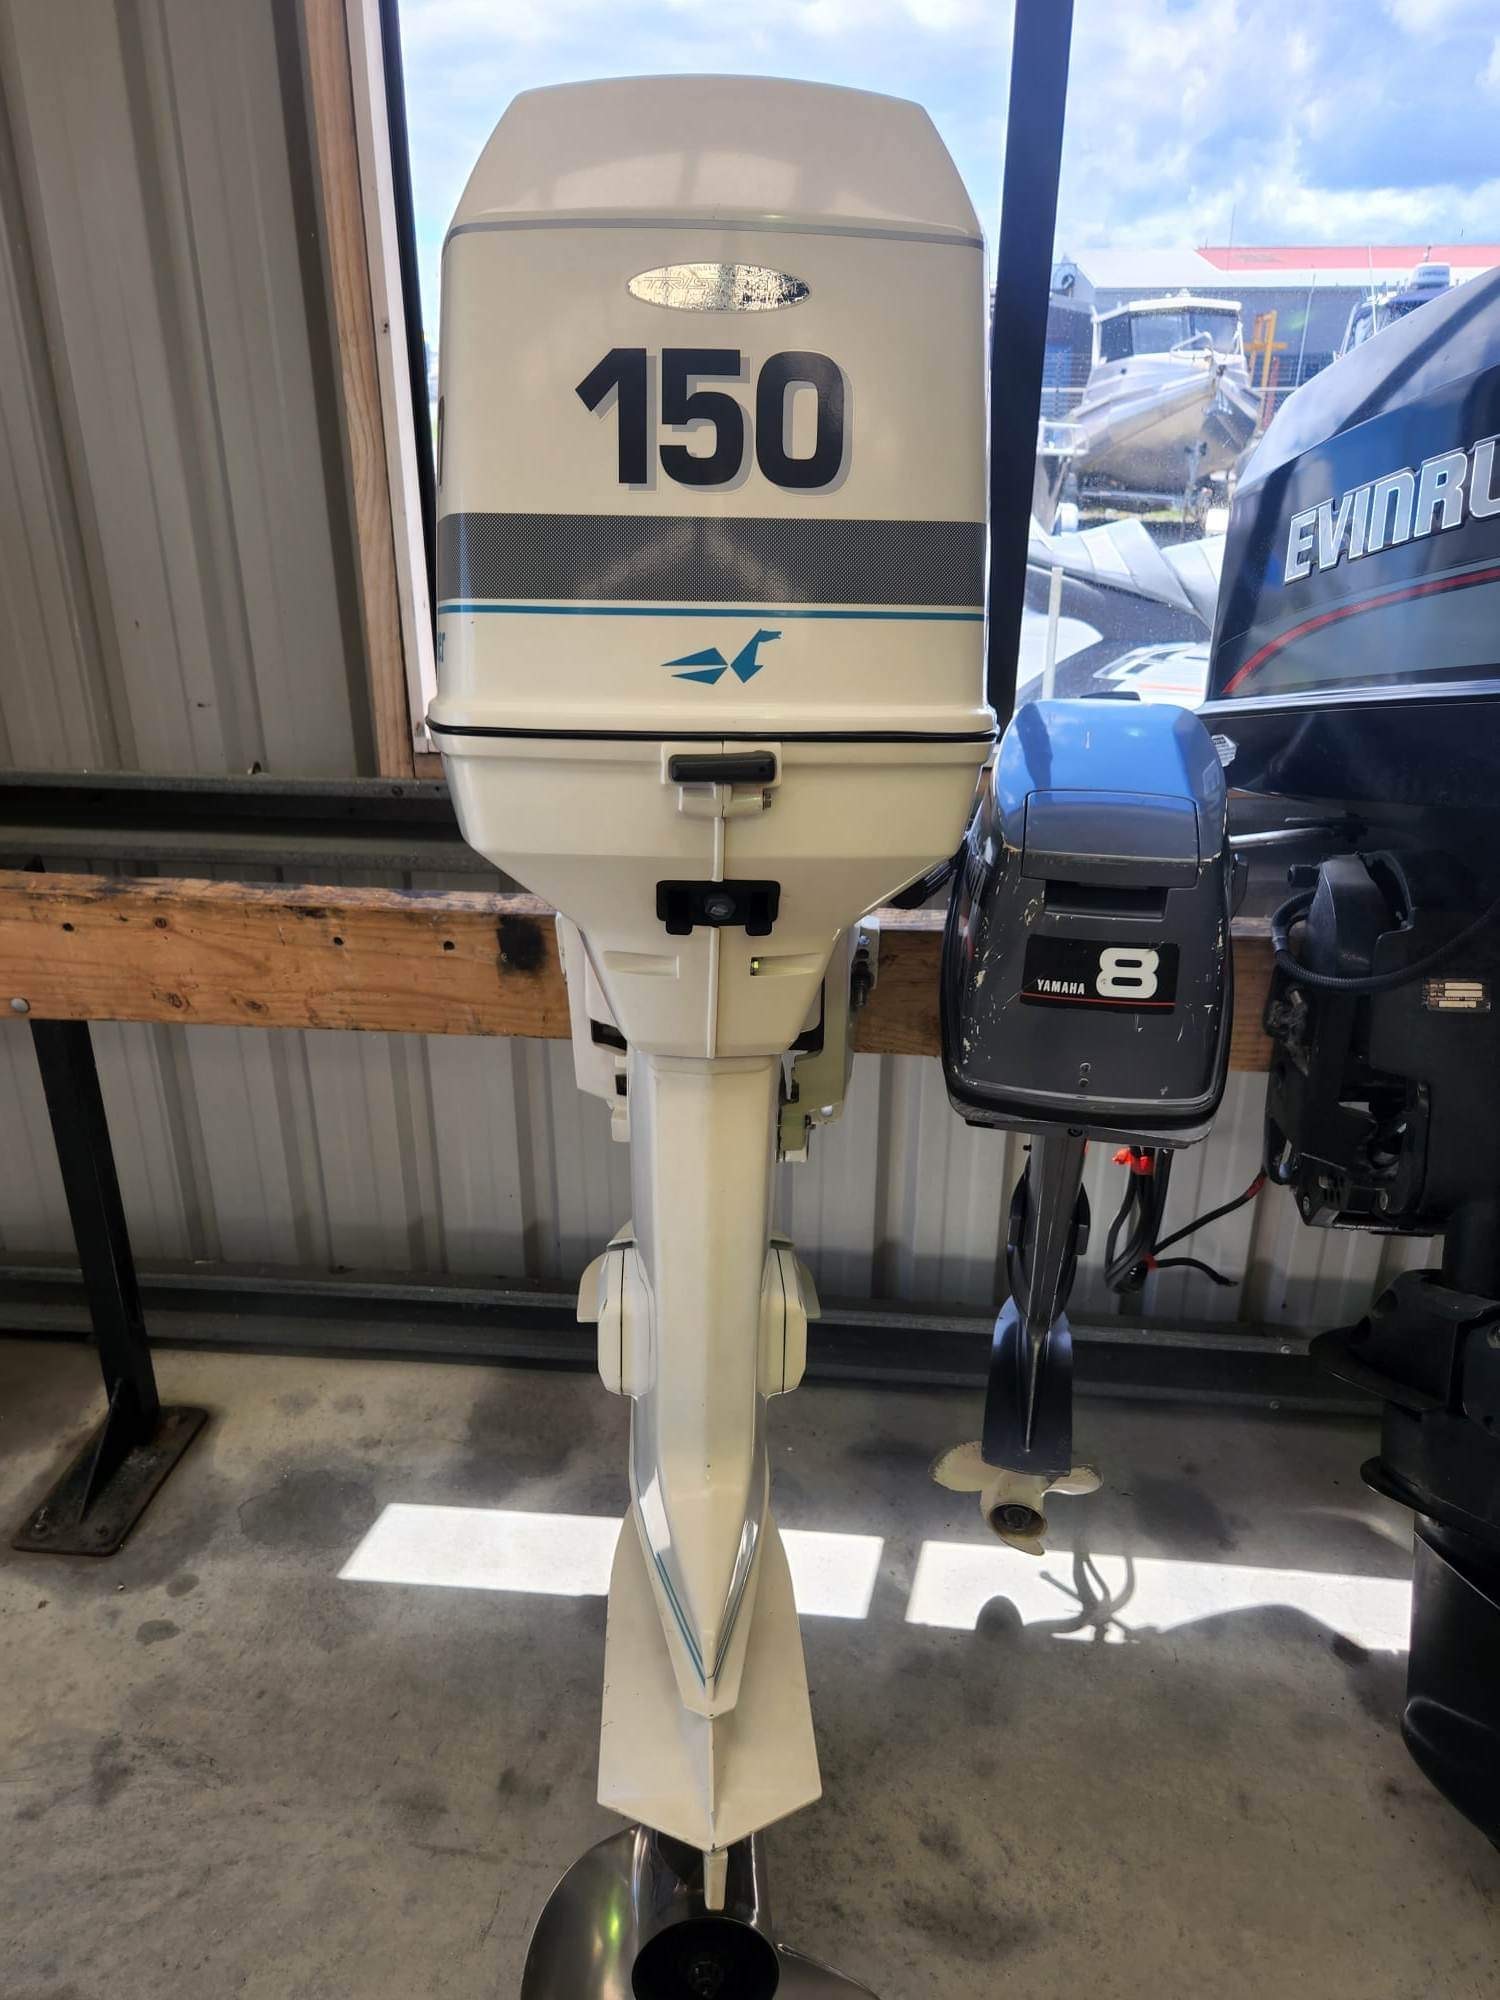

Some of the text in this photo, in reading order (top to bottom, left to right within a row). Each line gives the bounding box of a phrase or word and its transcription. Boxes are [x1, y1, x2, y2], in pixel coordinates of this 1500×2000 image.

[575, 347, 854, 495] 150
[1036, 947, 1160, 999] YAMAHA 8
